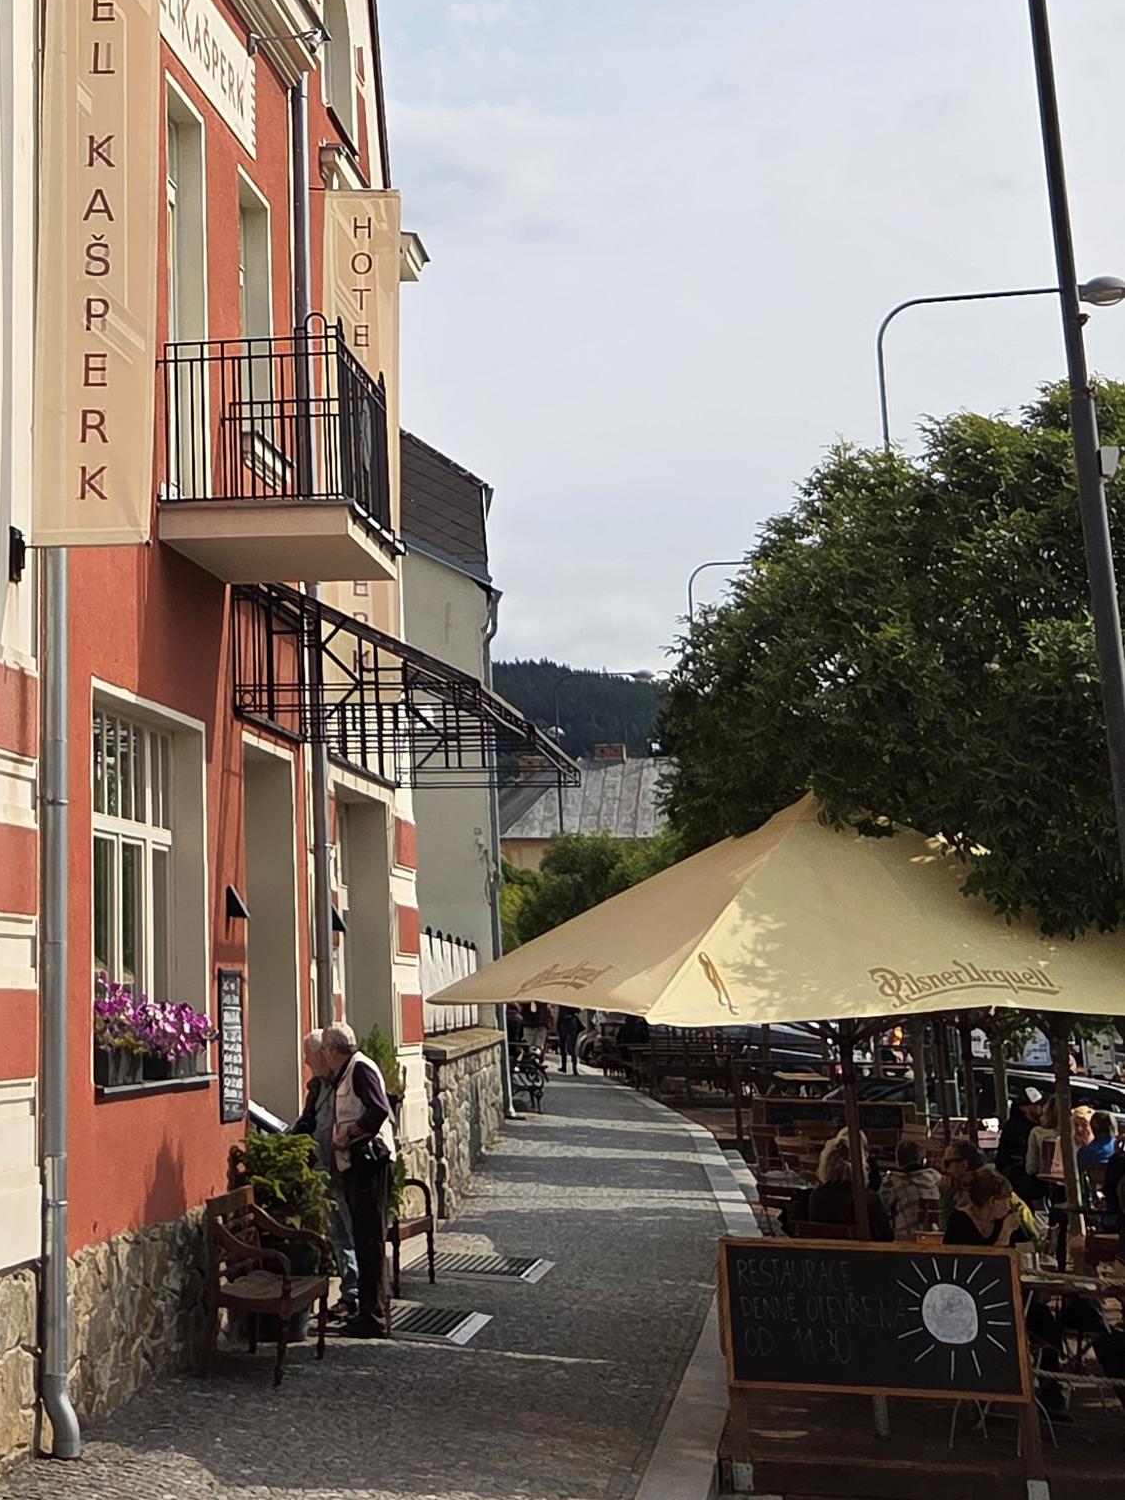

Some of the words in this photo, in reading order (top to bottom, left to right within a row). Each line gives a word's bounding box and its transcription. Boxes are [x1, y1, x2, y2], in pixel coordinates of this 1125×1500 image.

[79, 134, 116, 501] KAŠPERK
[351, 217, 373, 348] HOTE
[868, 966, 966, 1008] Pilsner
[952, 960, 1057, 994] Urquell
[736, 1258, 854, 1291] RESTAURACE
